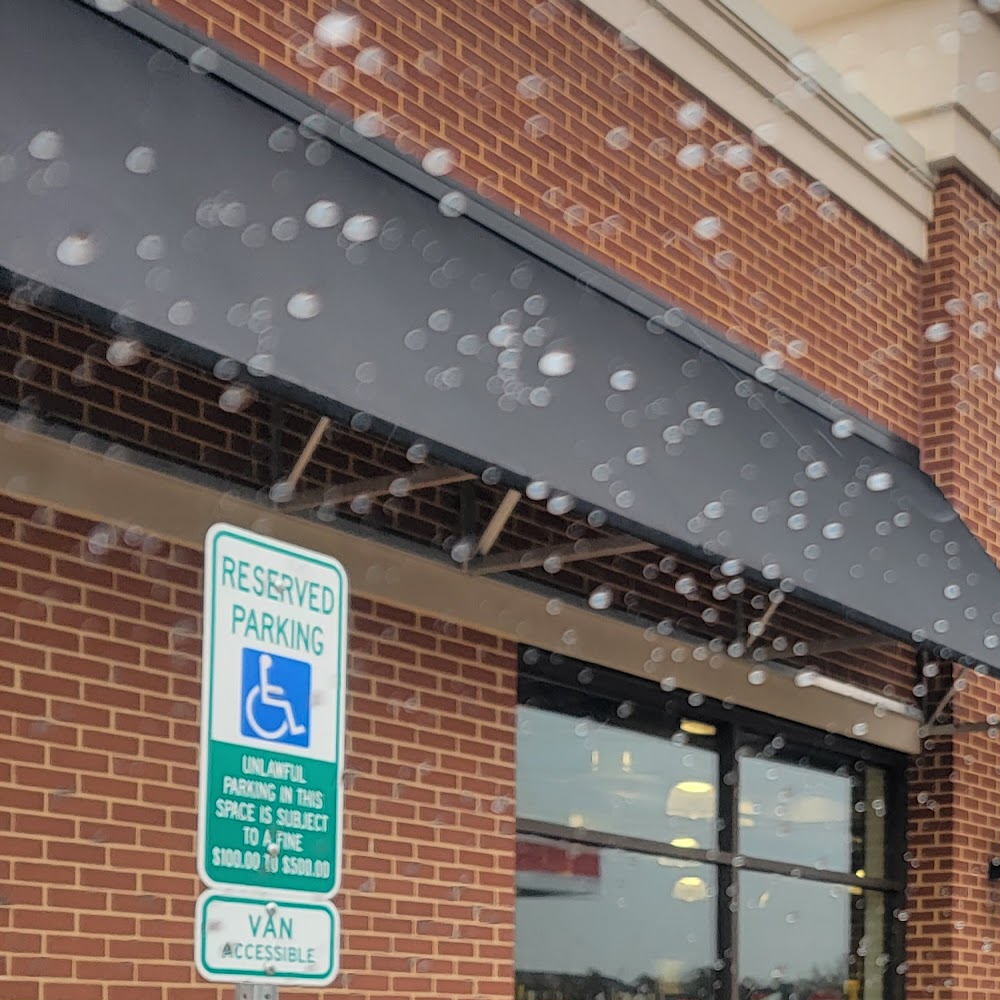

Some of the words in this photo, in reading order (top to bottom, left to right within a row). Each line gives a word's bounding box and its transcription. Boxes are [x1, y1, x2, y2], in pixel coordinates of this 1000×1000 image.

[221, 555, 335, 615] RESERVED
[231, 603, 325, 656] PARKING
[241, 755, 307, 784] UNLAWFUL
[222, 775, 277, 802] PARKING
[279, 785, 293, 804] IN
[296, 787, 323, 809] THIS
[215, 798, 256, 822] SPACE
[259, 805, 273, 824] IS
[276, 807, 329, 832] SUBJECT
[242, 826, 260, 846] TO
[262, 829, 273, 848] A
[275, 830, 304, 852] FINE
[211, 846, 261, 871] $100.00
[264, 852, 279, 873] TO
[281, 855, 331, 879] $500.00
[248, 913, 293, 939] VAN
[221, 942, 316, 963] ACCESSIBLE
